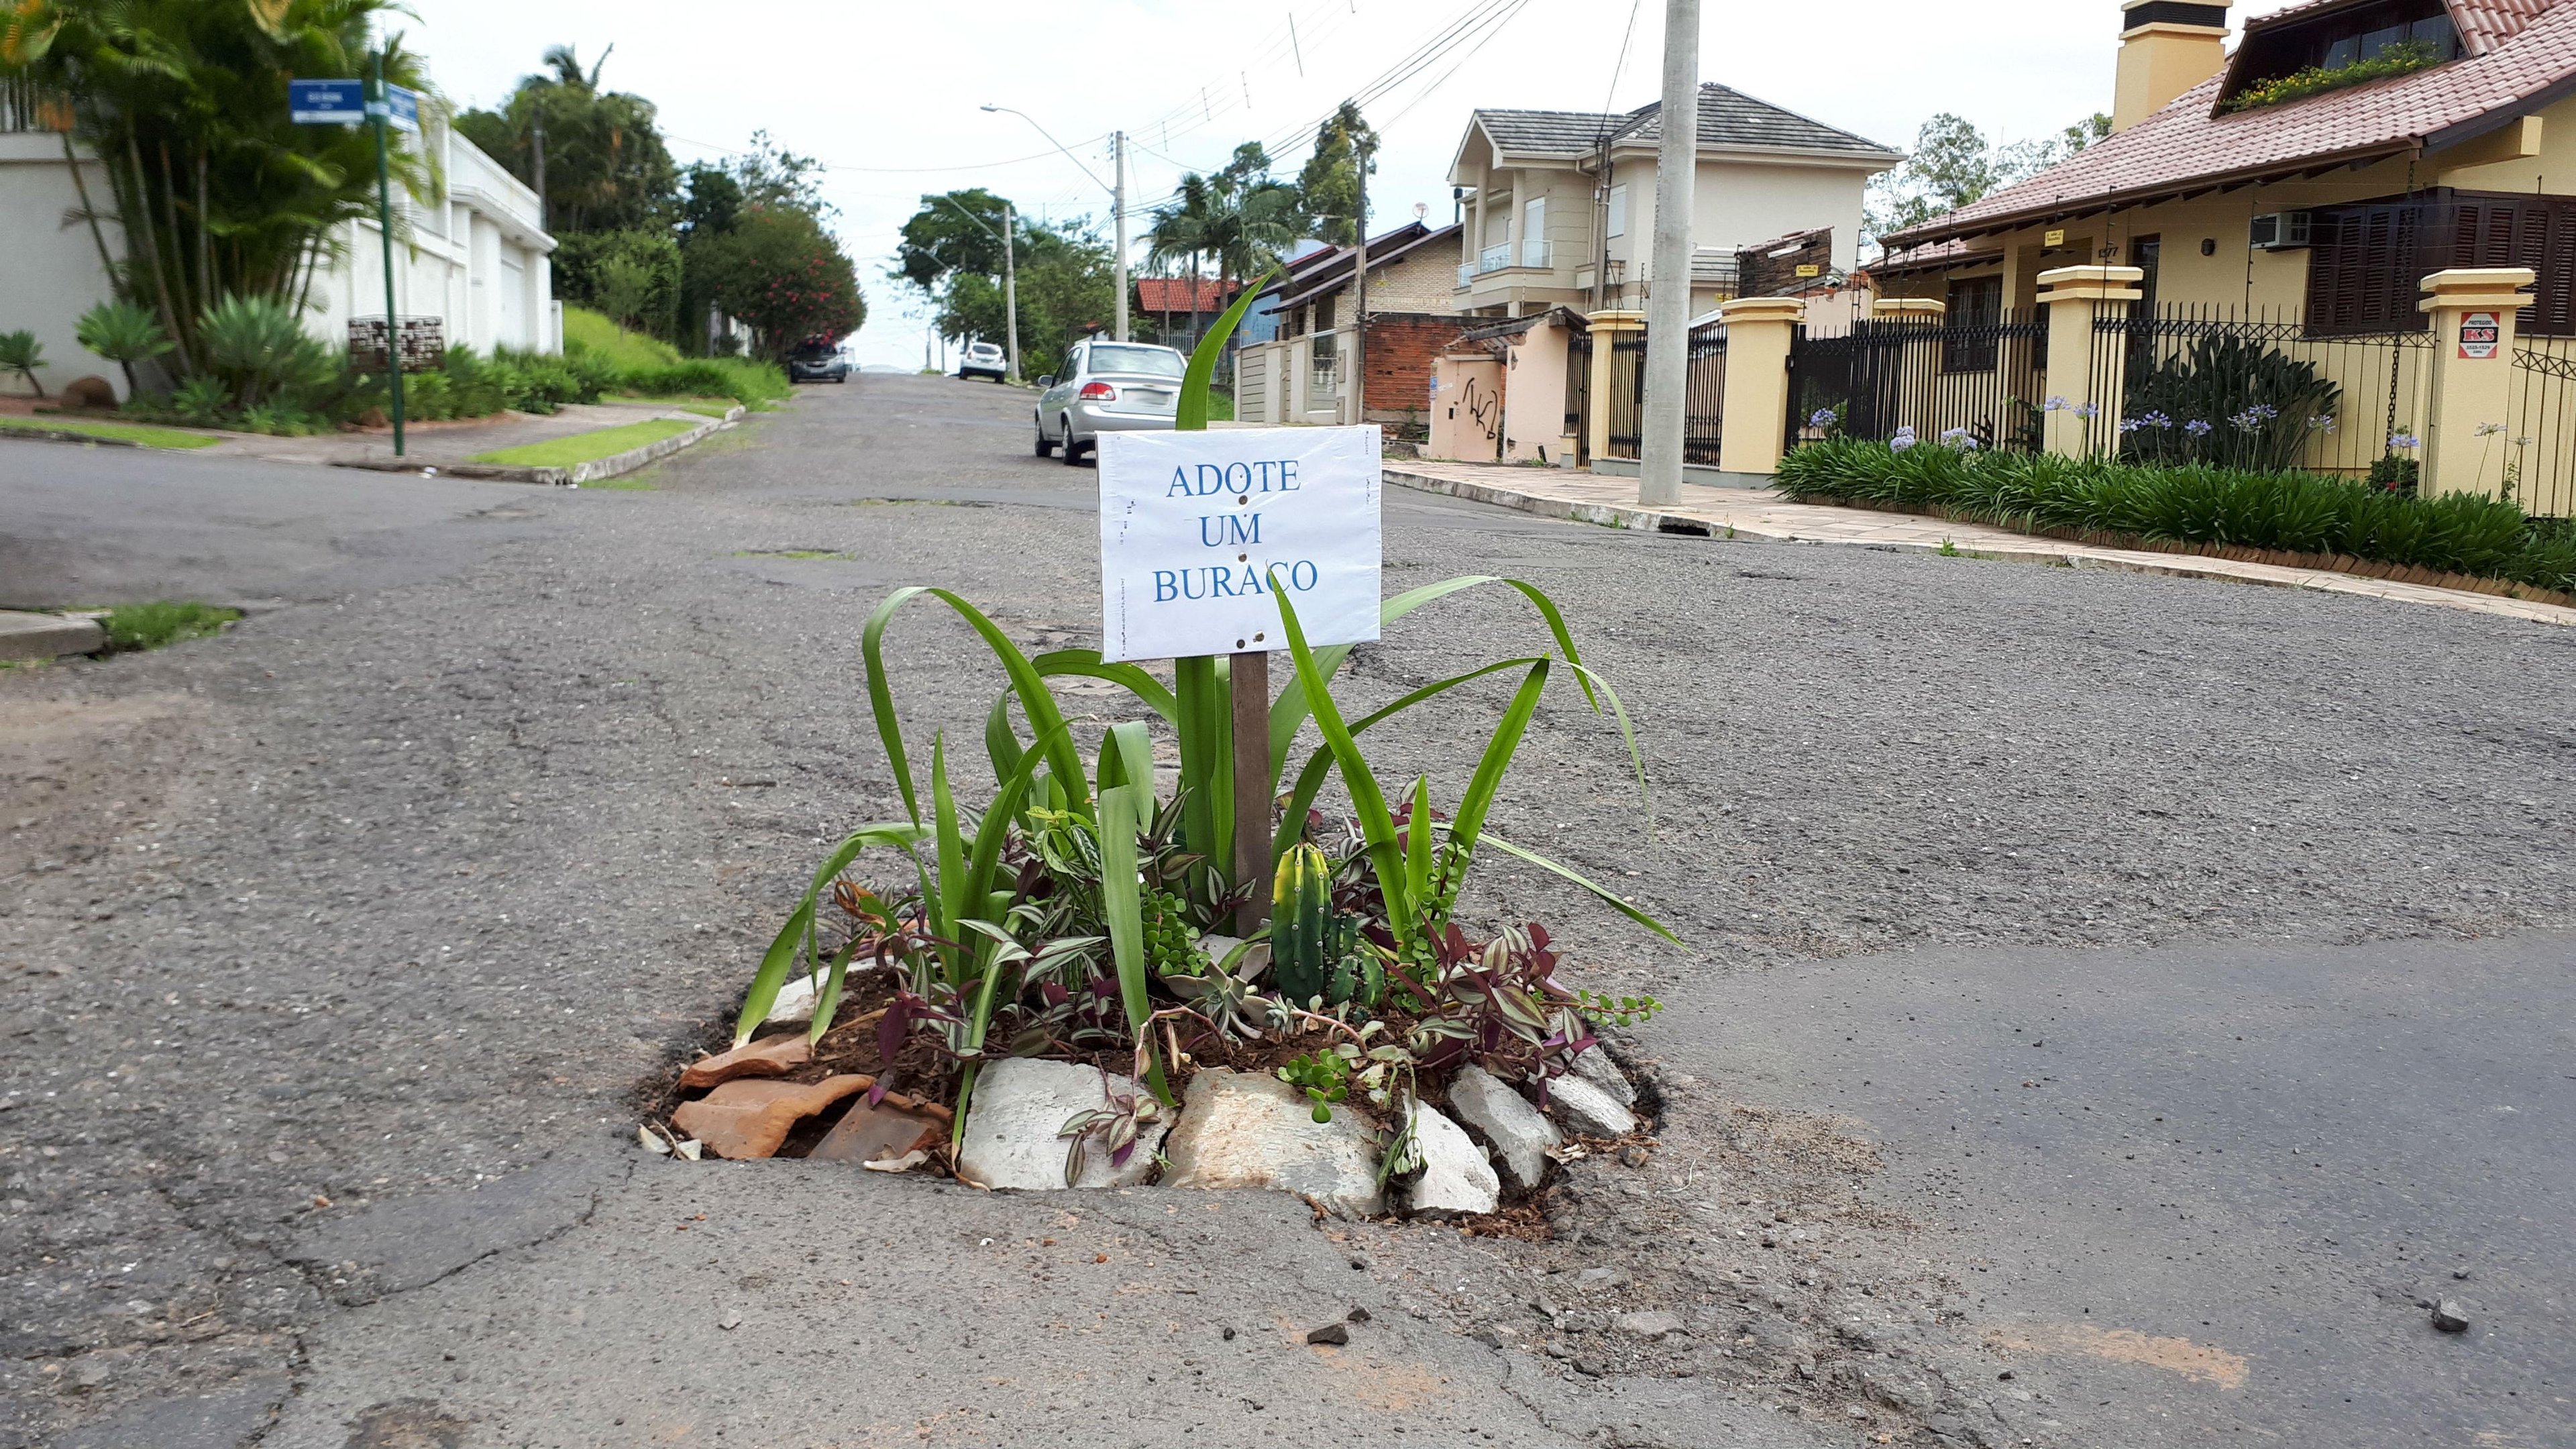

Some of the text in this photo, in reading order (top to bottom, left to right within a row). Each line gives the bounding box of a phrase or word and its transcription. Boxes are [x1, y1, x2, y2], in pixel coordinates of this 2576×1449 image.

[2463, 328, 2494, 341] KS
[1166, 460, 1301, 497] ADOTE
[1199, 513, 1262, 547] UM
[1153, 560, 1318, 602] BURACO
